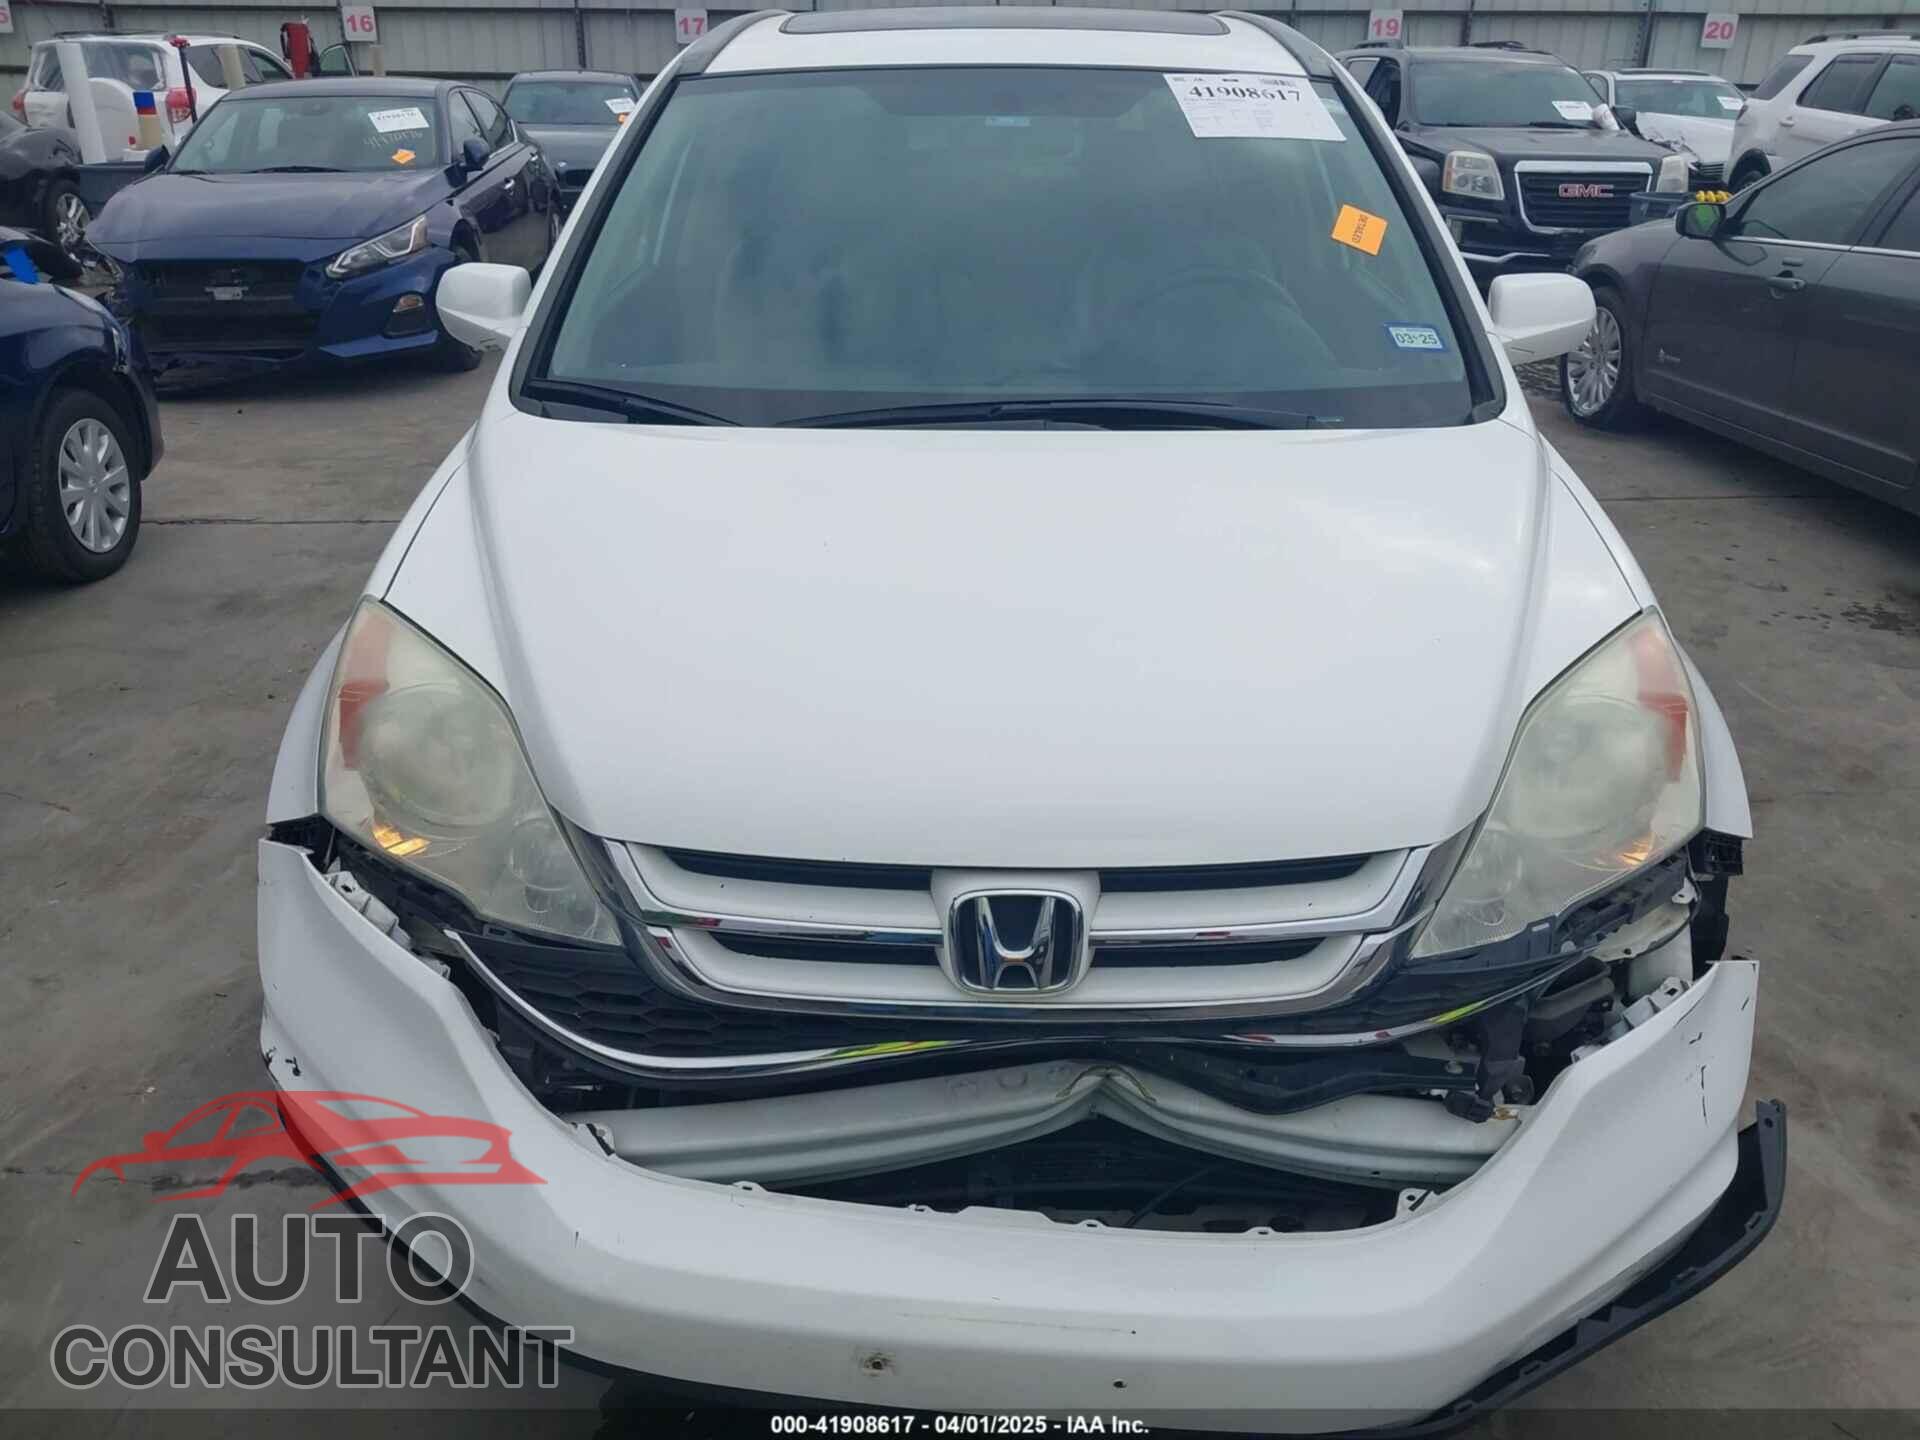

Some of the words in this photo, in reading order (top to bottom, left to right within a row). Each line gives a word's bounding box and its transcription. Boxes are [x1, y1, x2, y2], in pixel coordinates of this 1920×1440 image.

[346, 15, 374, 32] 16
[679, 16, 705, 35] 17
[1373, 18, 1399, 37] 19
[1705, 22, 1734, 40] 20
[1188, 85, 1301, 102] 41908617
[1558, 183, 1615, 198] GMC
